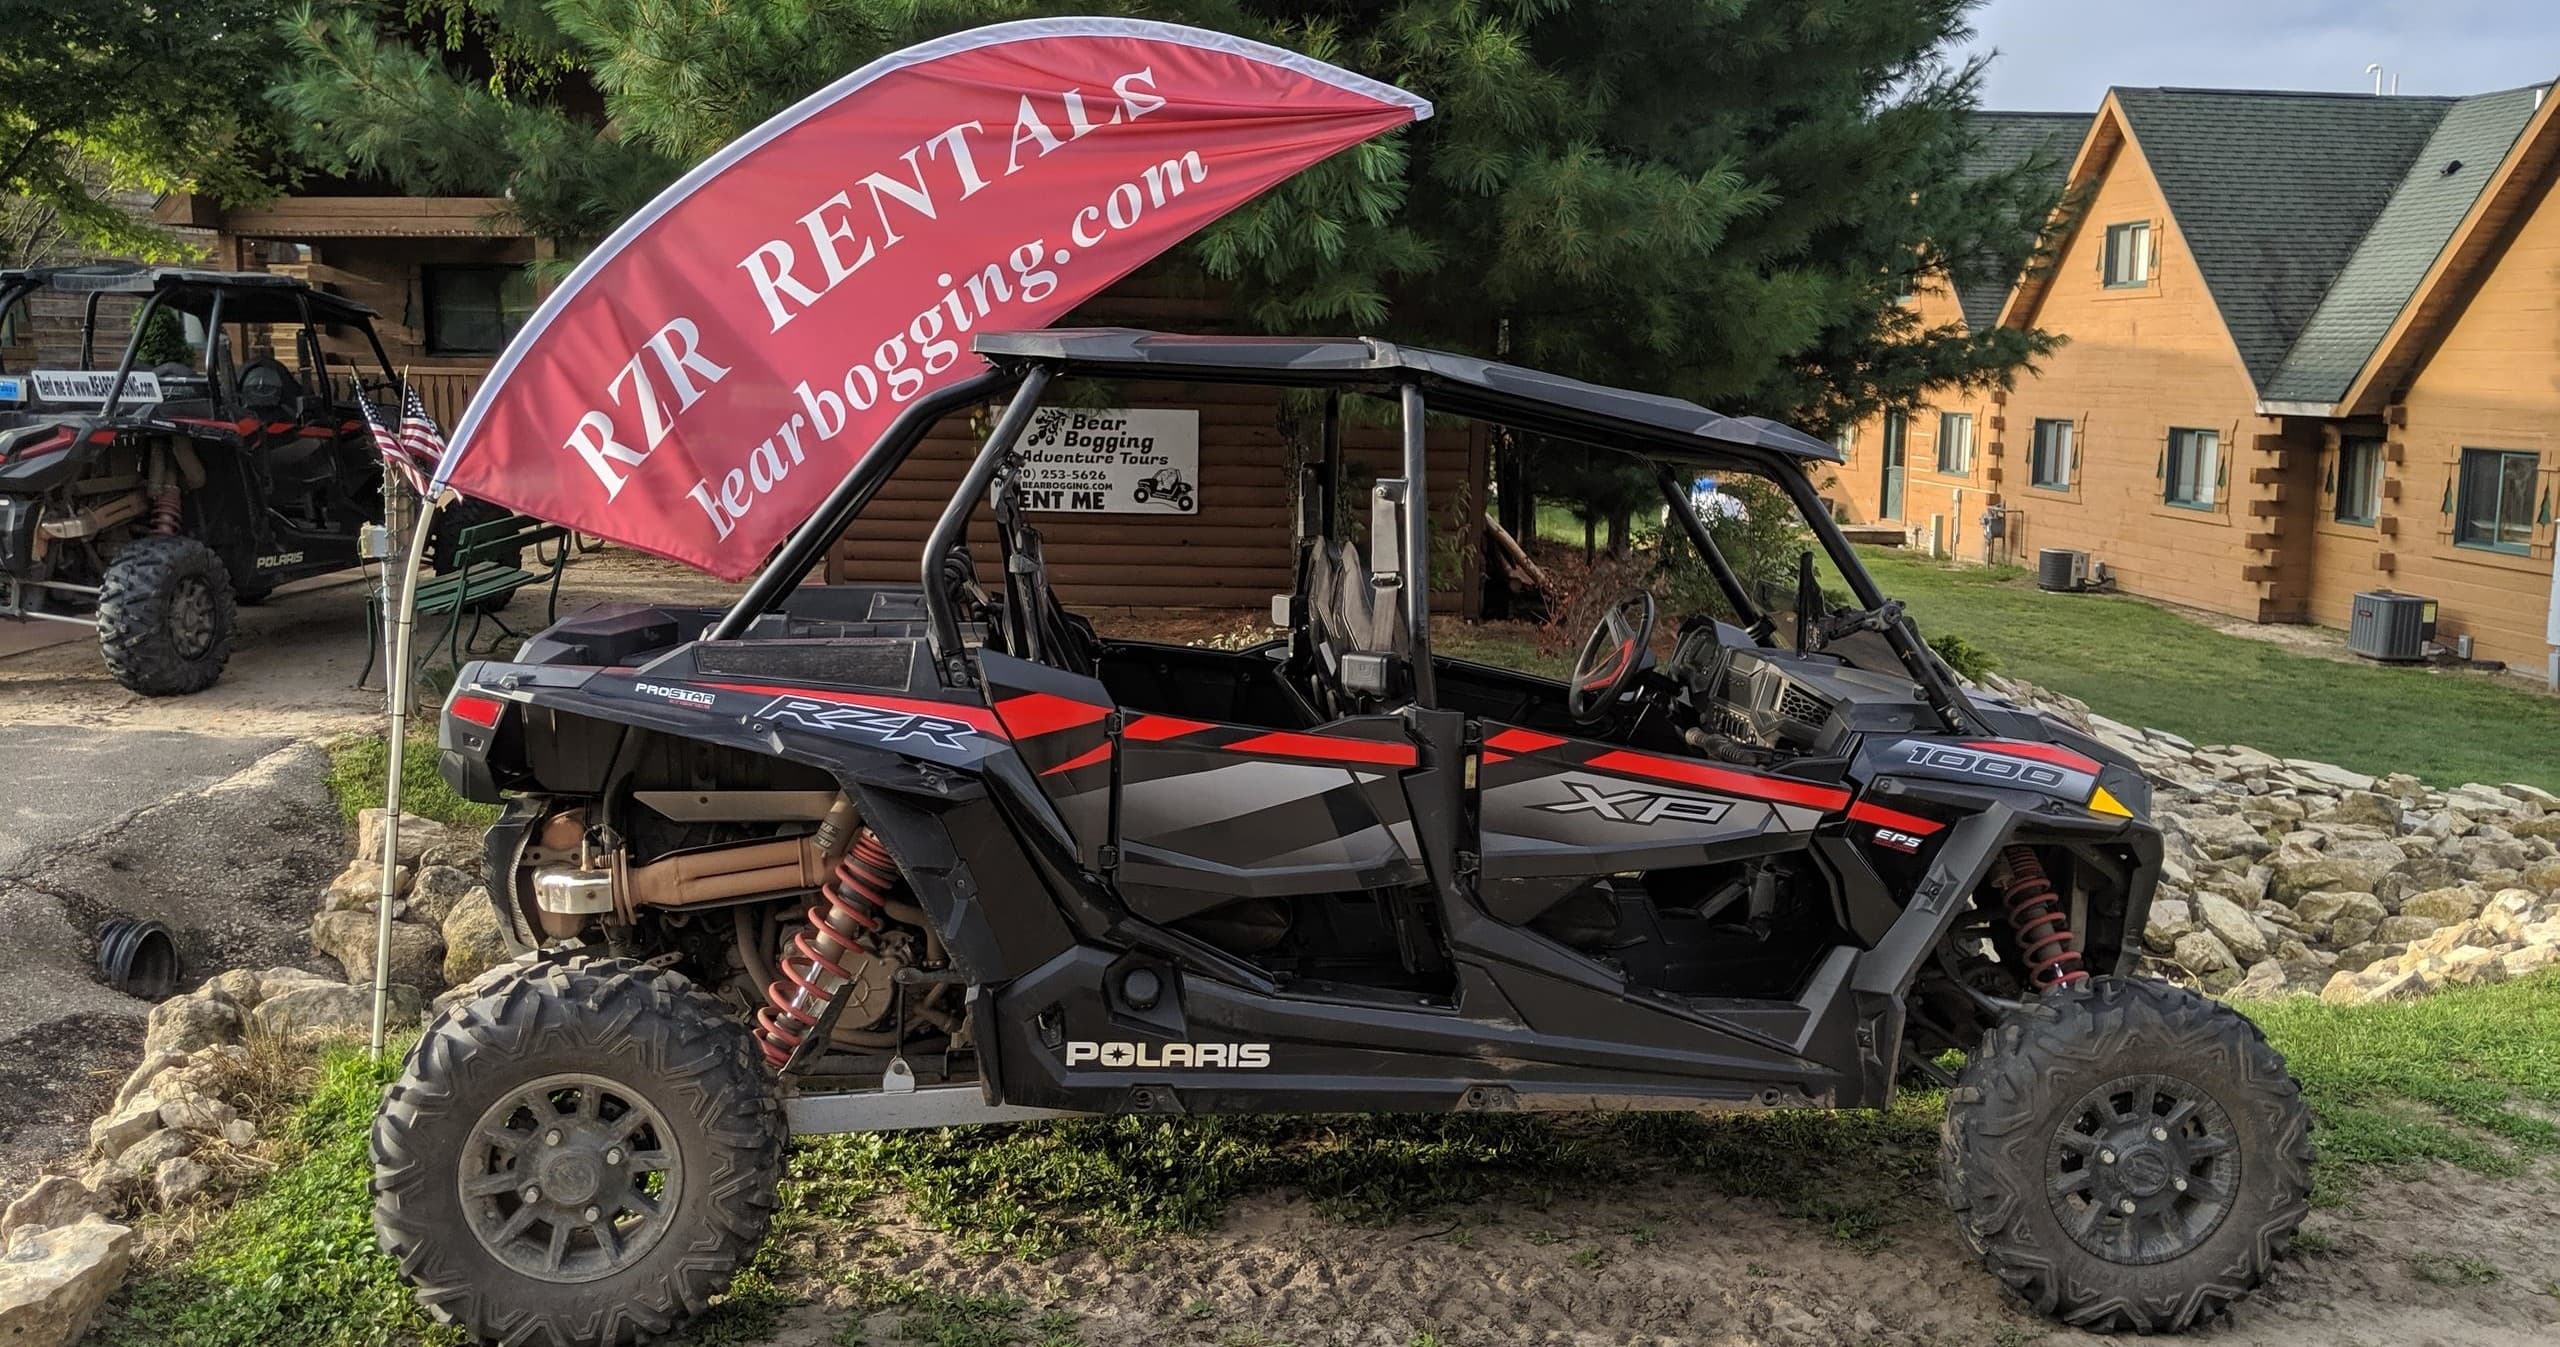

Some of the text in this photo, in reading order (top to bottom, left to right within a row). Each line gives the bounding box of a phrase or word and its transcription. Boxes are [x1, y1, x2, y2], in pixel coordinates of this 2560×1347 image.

[562, 66, 1167, 504] RZR RENTALS
[35, 374, 57, 396] Rent
[1072, 414, 1127, 430] Bear
[1063, 431, 1154, 453] Bogging
[1023, 450, 1169, 465] Adventure Tours
[1041, 469, 1106, 480] 253-5626
[1020, 490, 1105, 510] ENT ME
[256, 551, 304, 569] POLARIS
[634, 682, 716, 705] PROSTAR
[753, 694, 978, 751] RZR
[1906, 745, 2065, 788] 1000
[1530, 780, 1737, 826] XP
[1875, 829, 1924, 848] EPS
[1066, 1041, 1271, 1068] POLARIS
